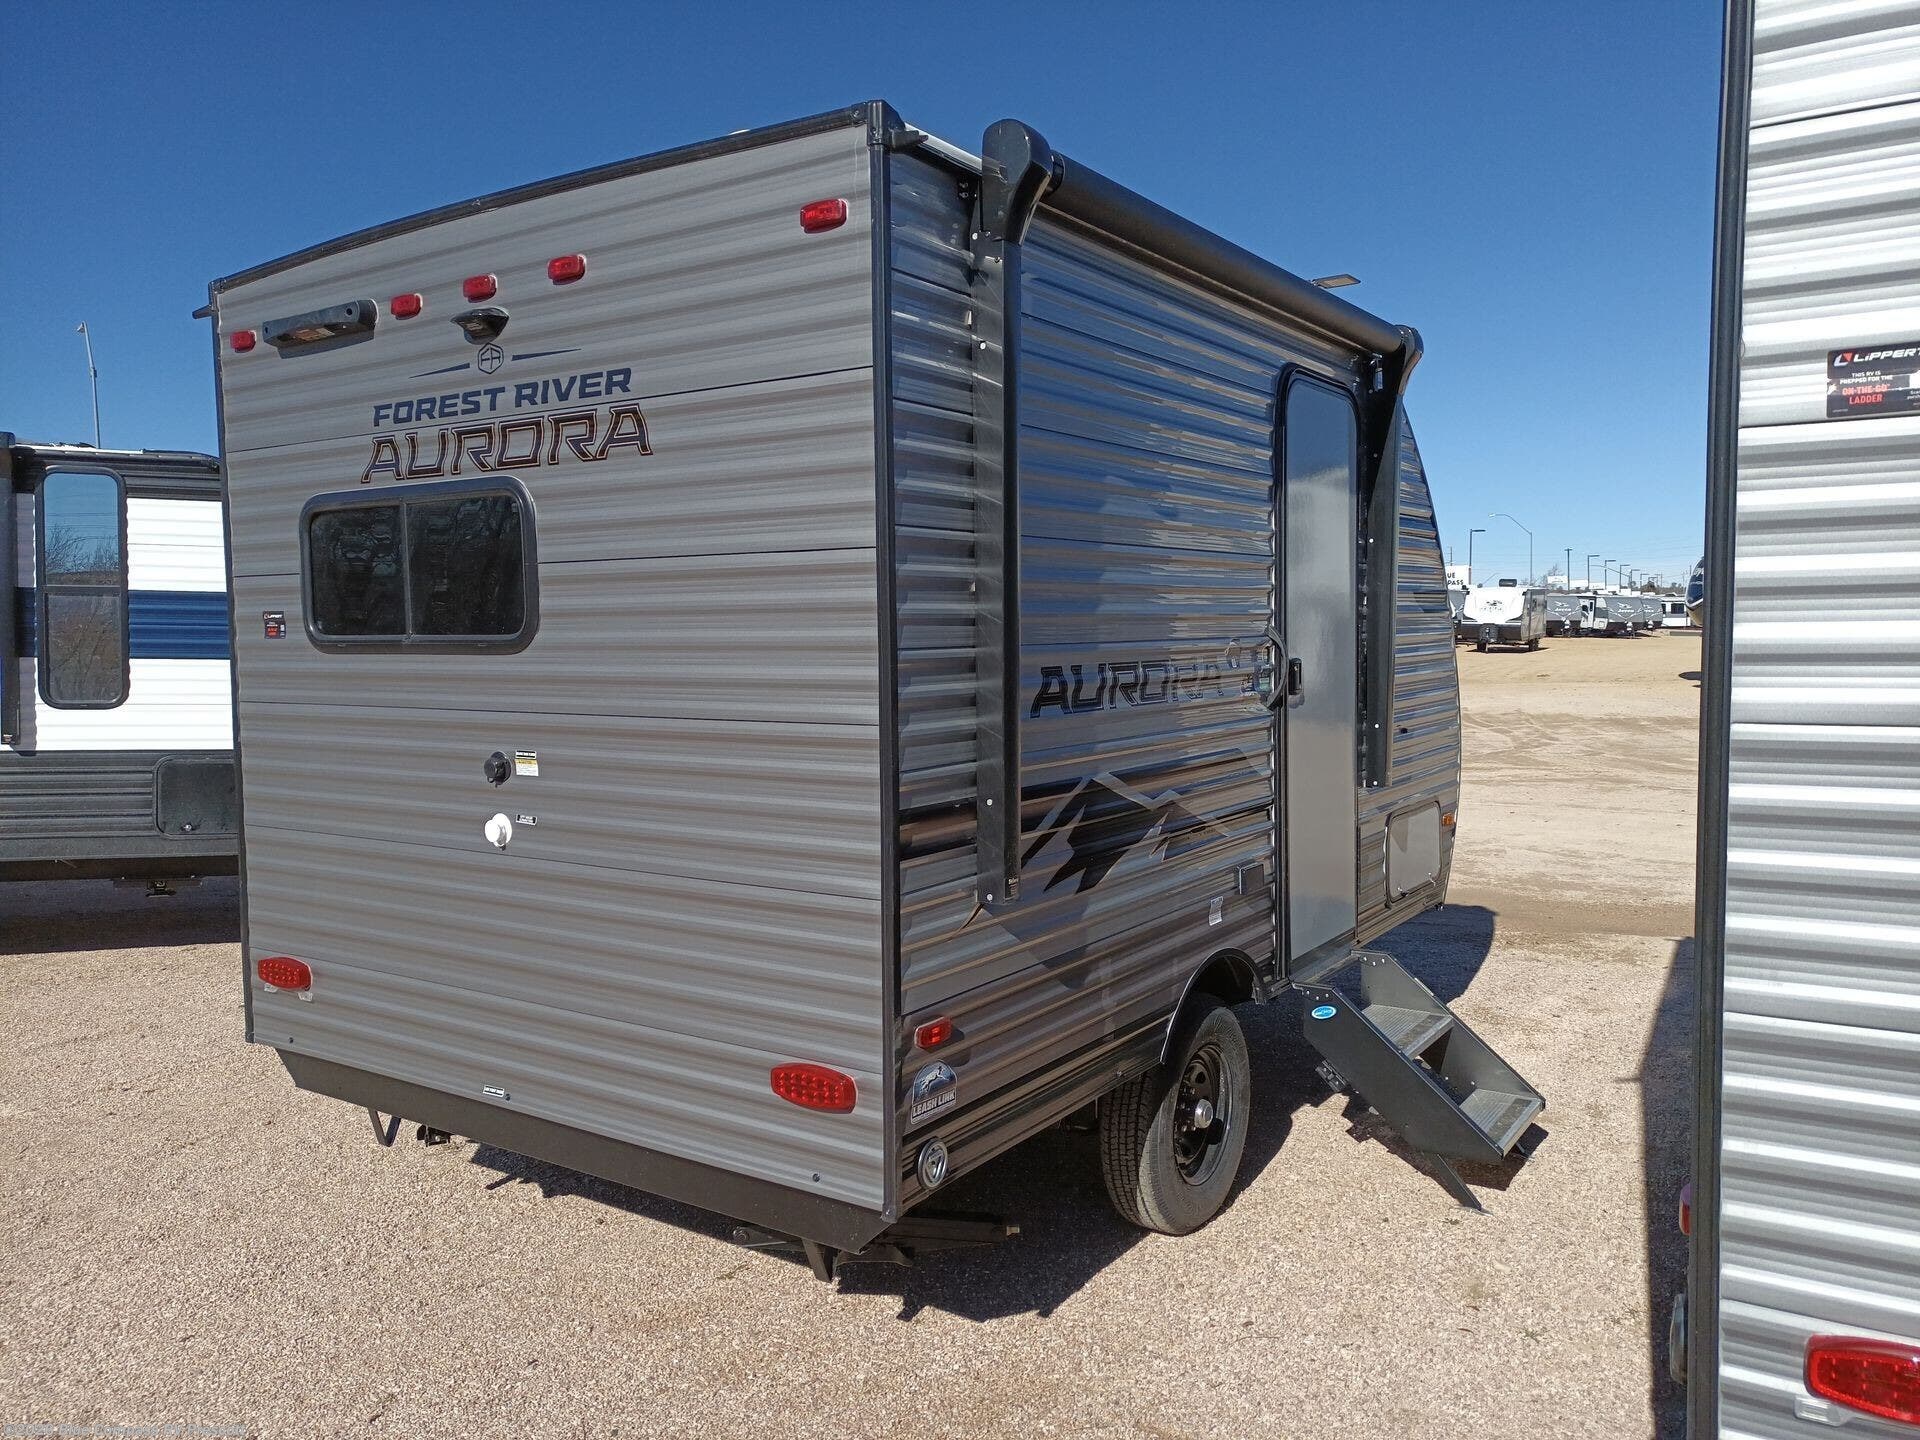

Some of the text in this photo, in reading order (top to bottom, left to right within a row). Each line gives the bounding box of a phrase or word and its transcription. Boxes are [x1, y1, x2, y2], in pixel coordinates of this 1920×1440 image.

[373, 367, 632, 427] FOREST RIVER
[1849, 394, 1883, 405] LADDER
[361, 402, 654, 484] AURORA
[912, 1090, 955, 1117] LEASH LINK
